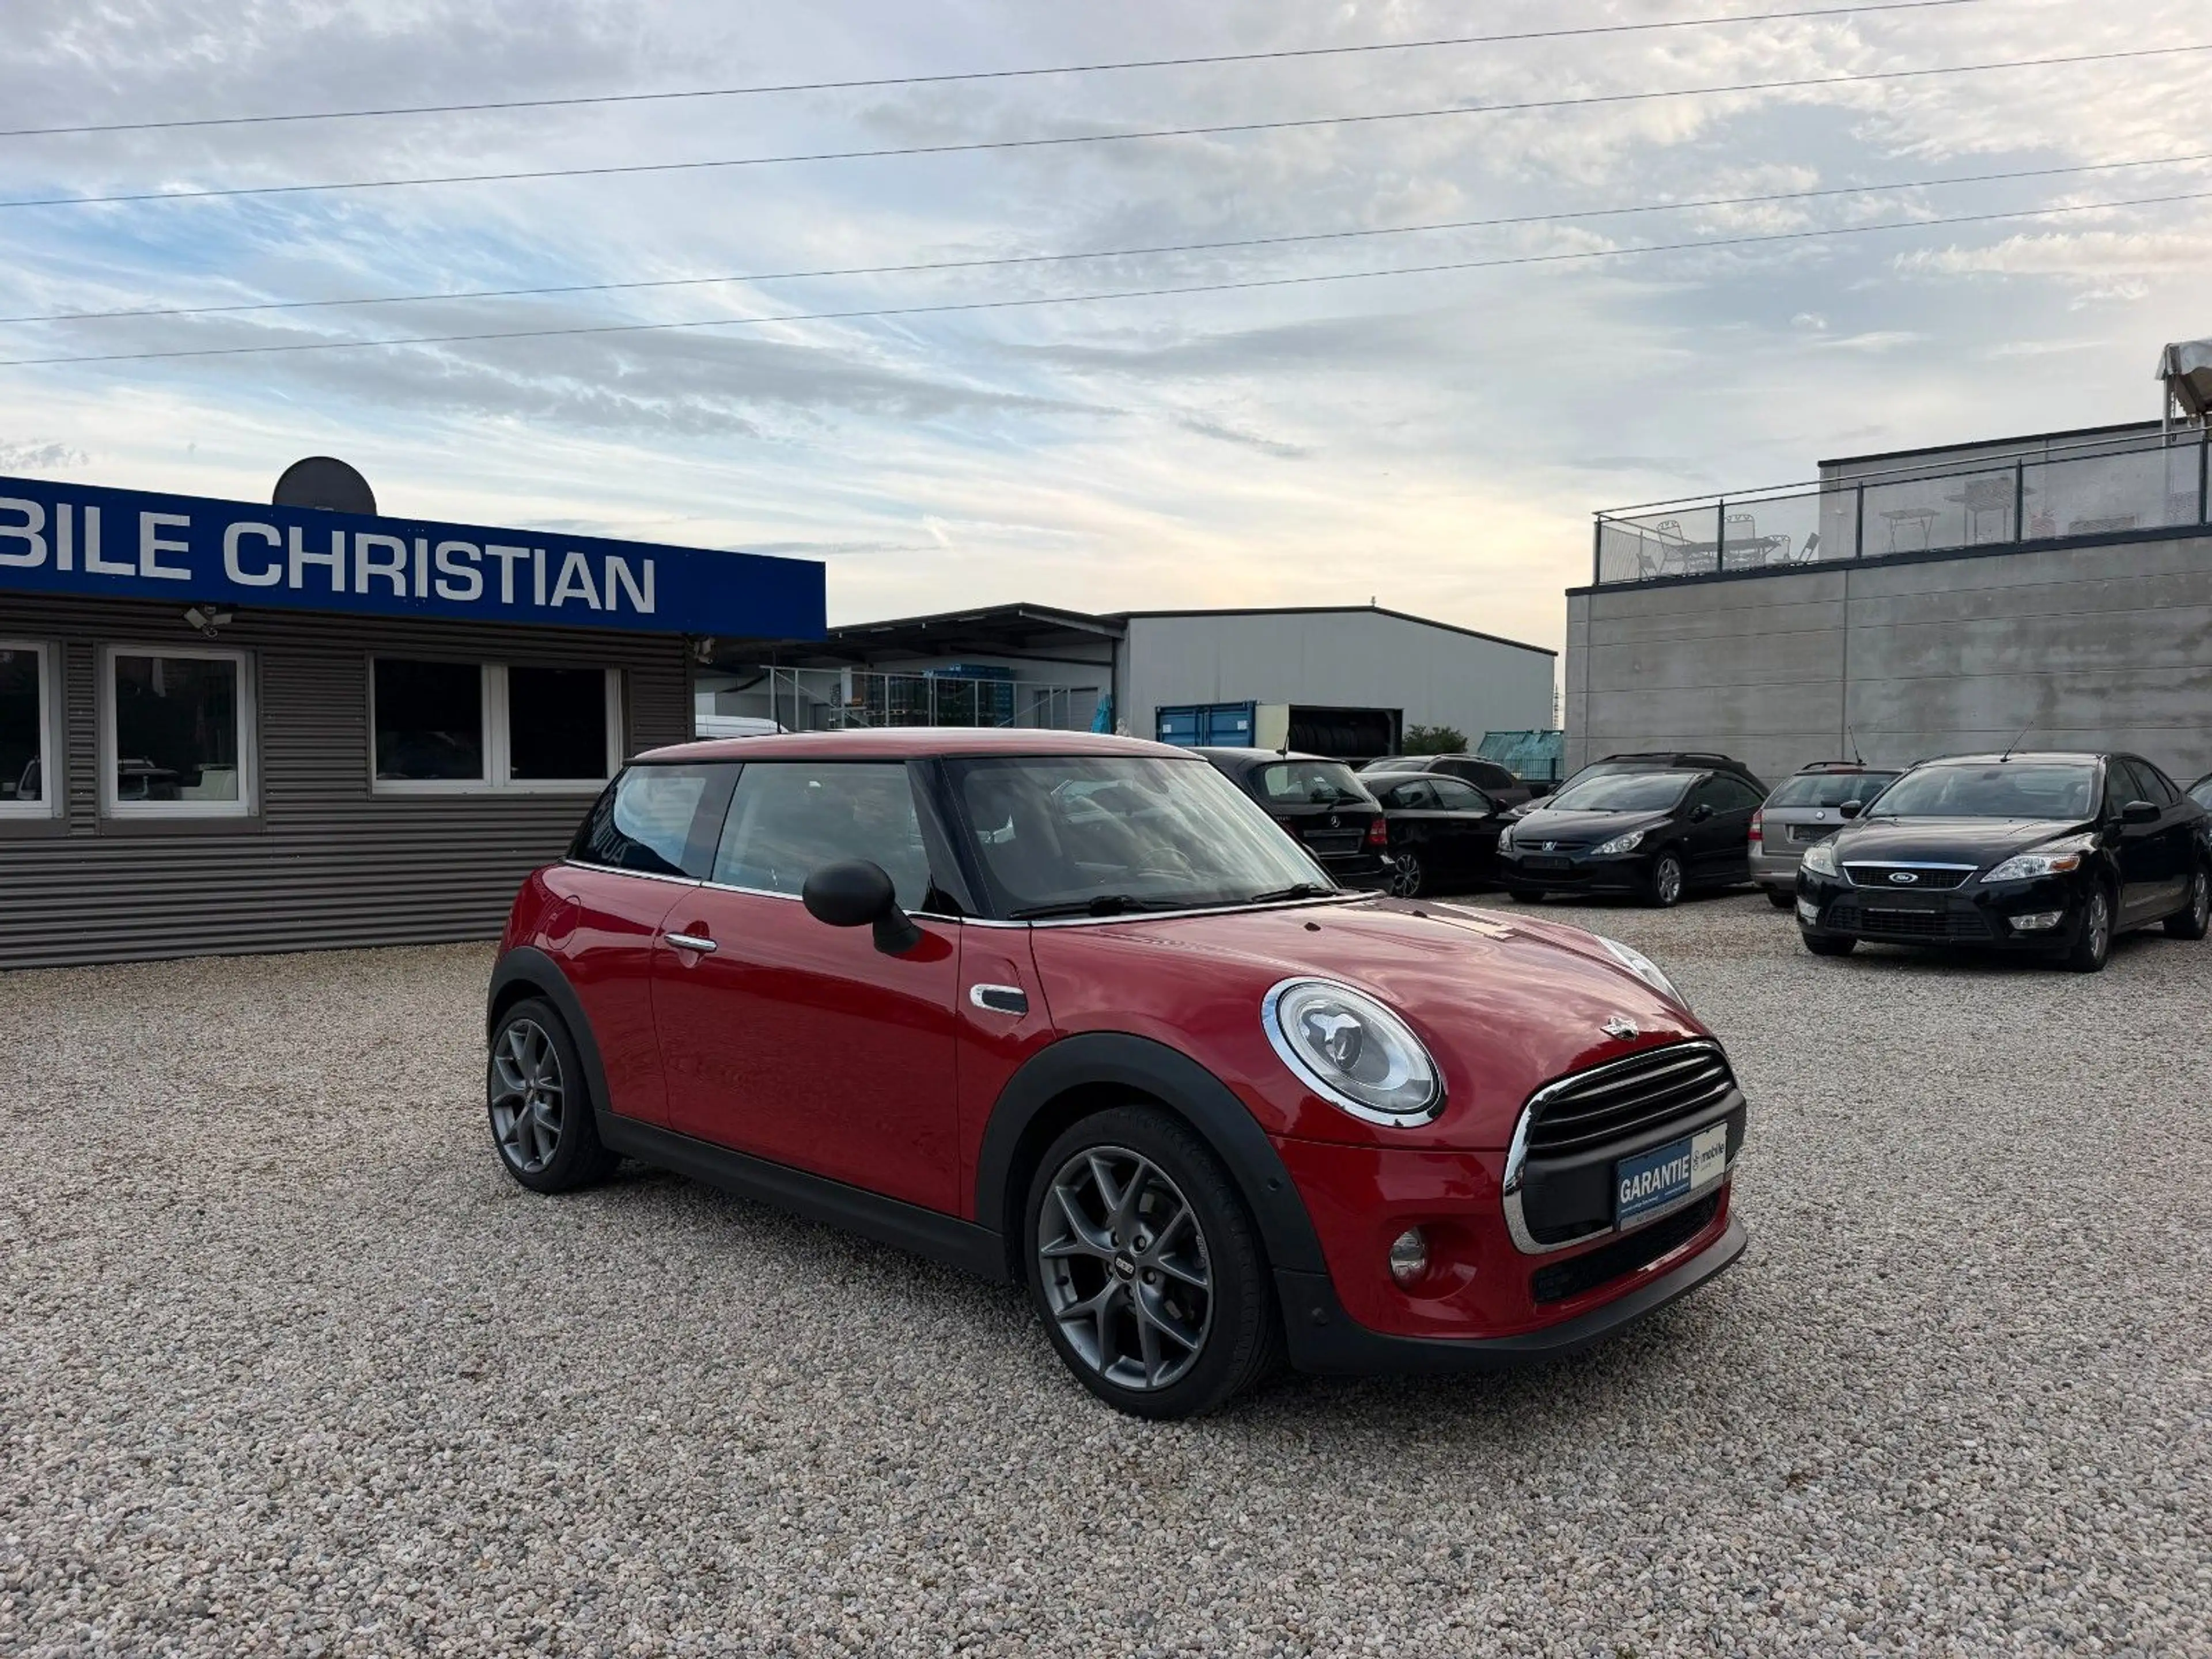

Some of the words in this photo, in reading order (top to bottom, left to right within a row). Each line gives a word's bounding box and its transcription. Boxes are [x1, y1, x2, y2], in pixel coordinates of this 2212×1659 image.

[0, 497, 192, 580] BILE
[224, 521, 655, 613] CHRISTIAN
[1620, 1154, 1691, 1203] GARANTIE
